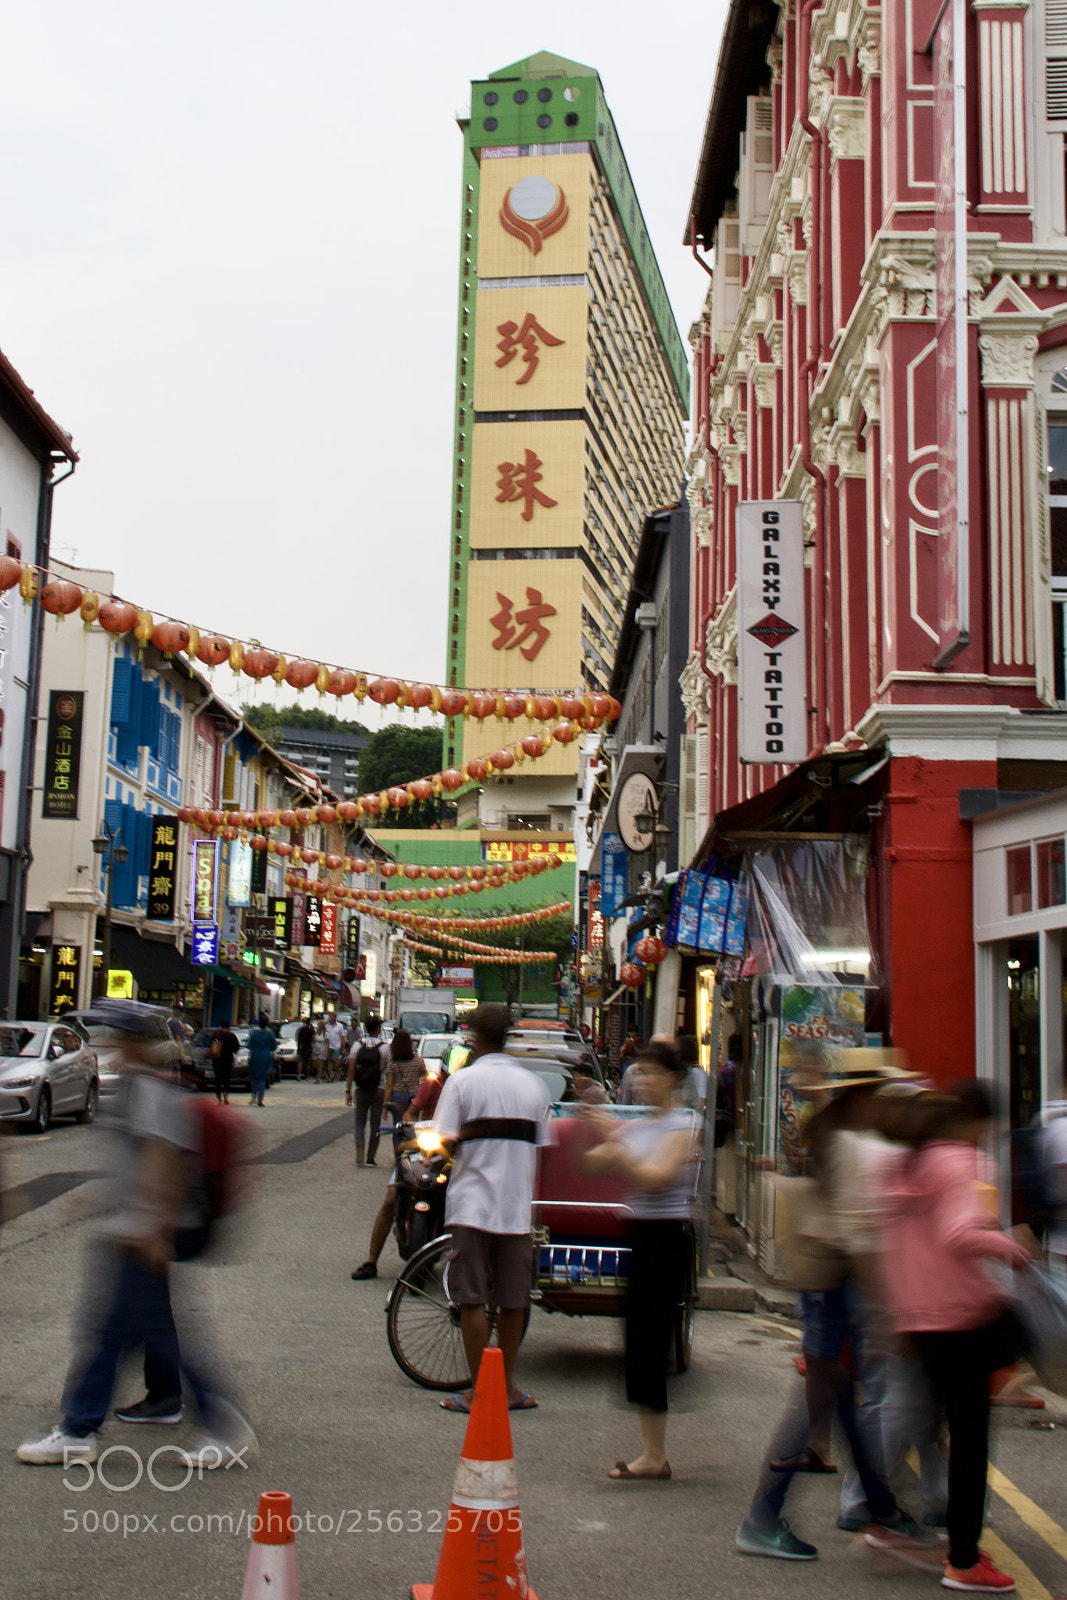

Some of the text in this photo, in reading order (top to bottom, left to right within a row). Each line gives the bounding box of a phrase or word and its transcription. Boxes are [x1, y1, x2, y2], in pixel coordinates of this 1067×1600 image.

[489, 312, 566, 662] 珍珠坊
[761, 511, 780, 610] GALAXY
[764, 652, 784, 753] TATTOO
[53, 724, 73, 790] 金山酒店
[152, 902, 169, 915] 39
